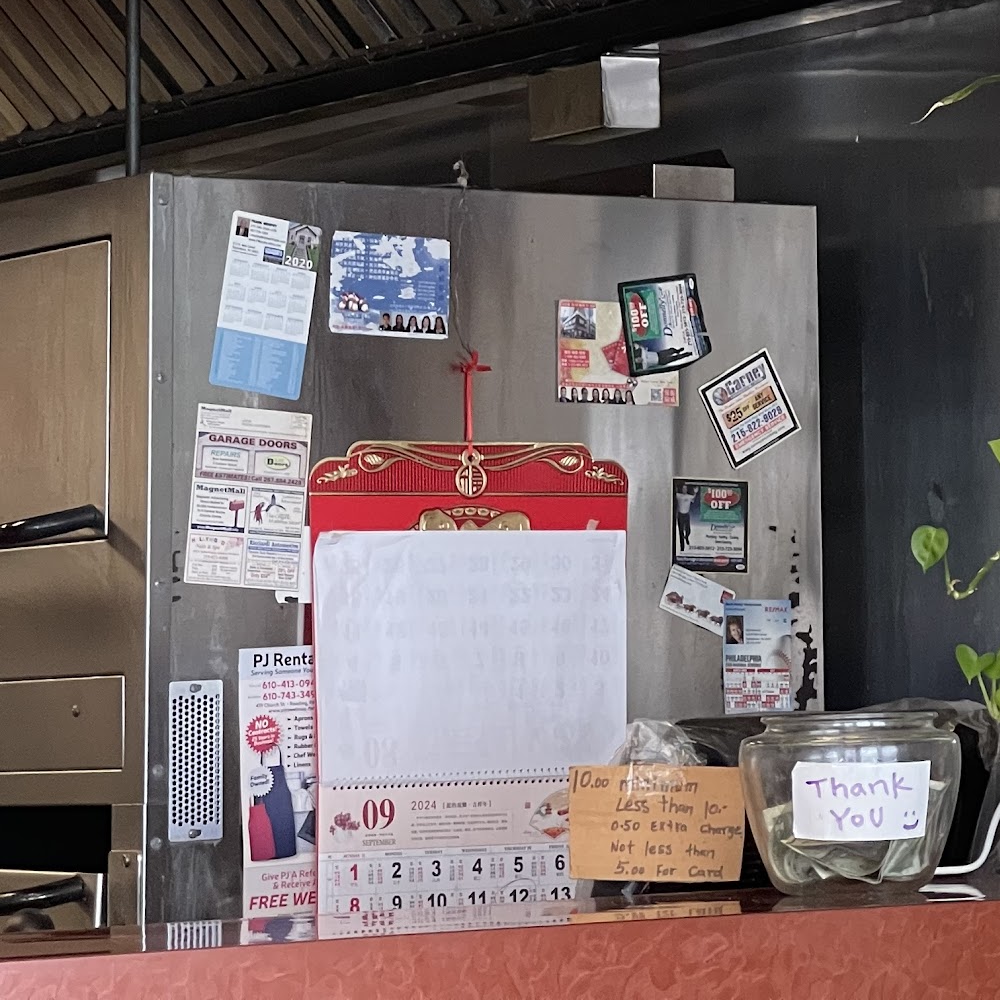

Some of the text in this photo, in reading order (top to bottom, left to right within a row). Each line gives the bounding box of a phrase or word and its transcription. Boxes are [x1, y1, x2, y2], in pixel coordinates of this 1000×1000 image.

[285, 256, 313, 270] 2020
[725, 363, 767, 396] Carney
[726, 407, 744, 423] $25
[209, 434, 297, 450] GARAGE DOORS
[211, 450, 241, 458] REPAIRS
[196, 484, 246, 494] MagnetMall
[711, 501, 731, 510] OFF
[253, 653, 269, 668] PJ
[255, 719, 269, 730] NO
[573, 769, 609, 793] 10.00
[805, 771, 913, 799] Thank
[411, 800, 437, 811] 2024
[615, 797, 650, 814] Less
[362, 798, 395, 830] 09
[611, 820, 640, 831] 0.50
[362, 839, 396, 847] SEPTEMBER
[611, 840, 635, 854] Not
[645, 841, 673, 856] less
[350, 854, 565, 881] 1 2 3 4 5 6
[614, 861, 645, 875] 5.00
[688, 865, 724, 879] Card
[261, 873, 279, 881] Give
[281, 871, 290, 879] PJ
[281, 880, 311, 889] Receive
[249, 891, 316, 910] FREE WE
[350, 887, 571, 912] 8 9 10 11 12 13
